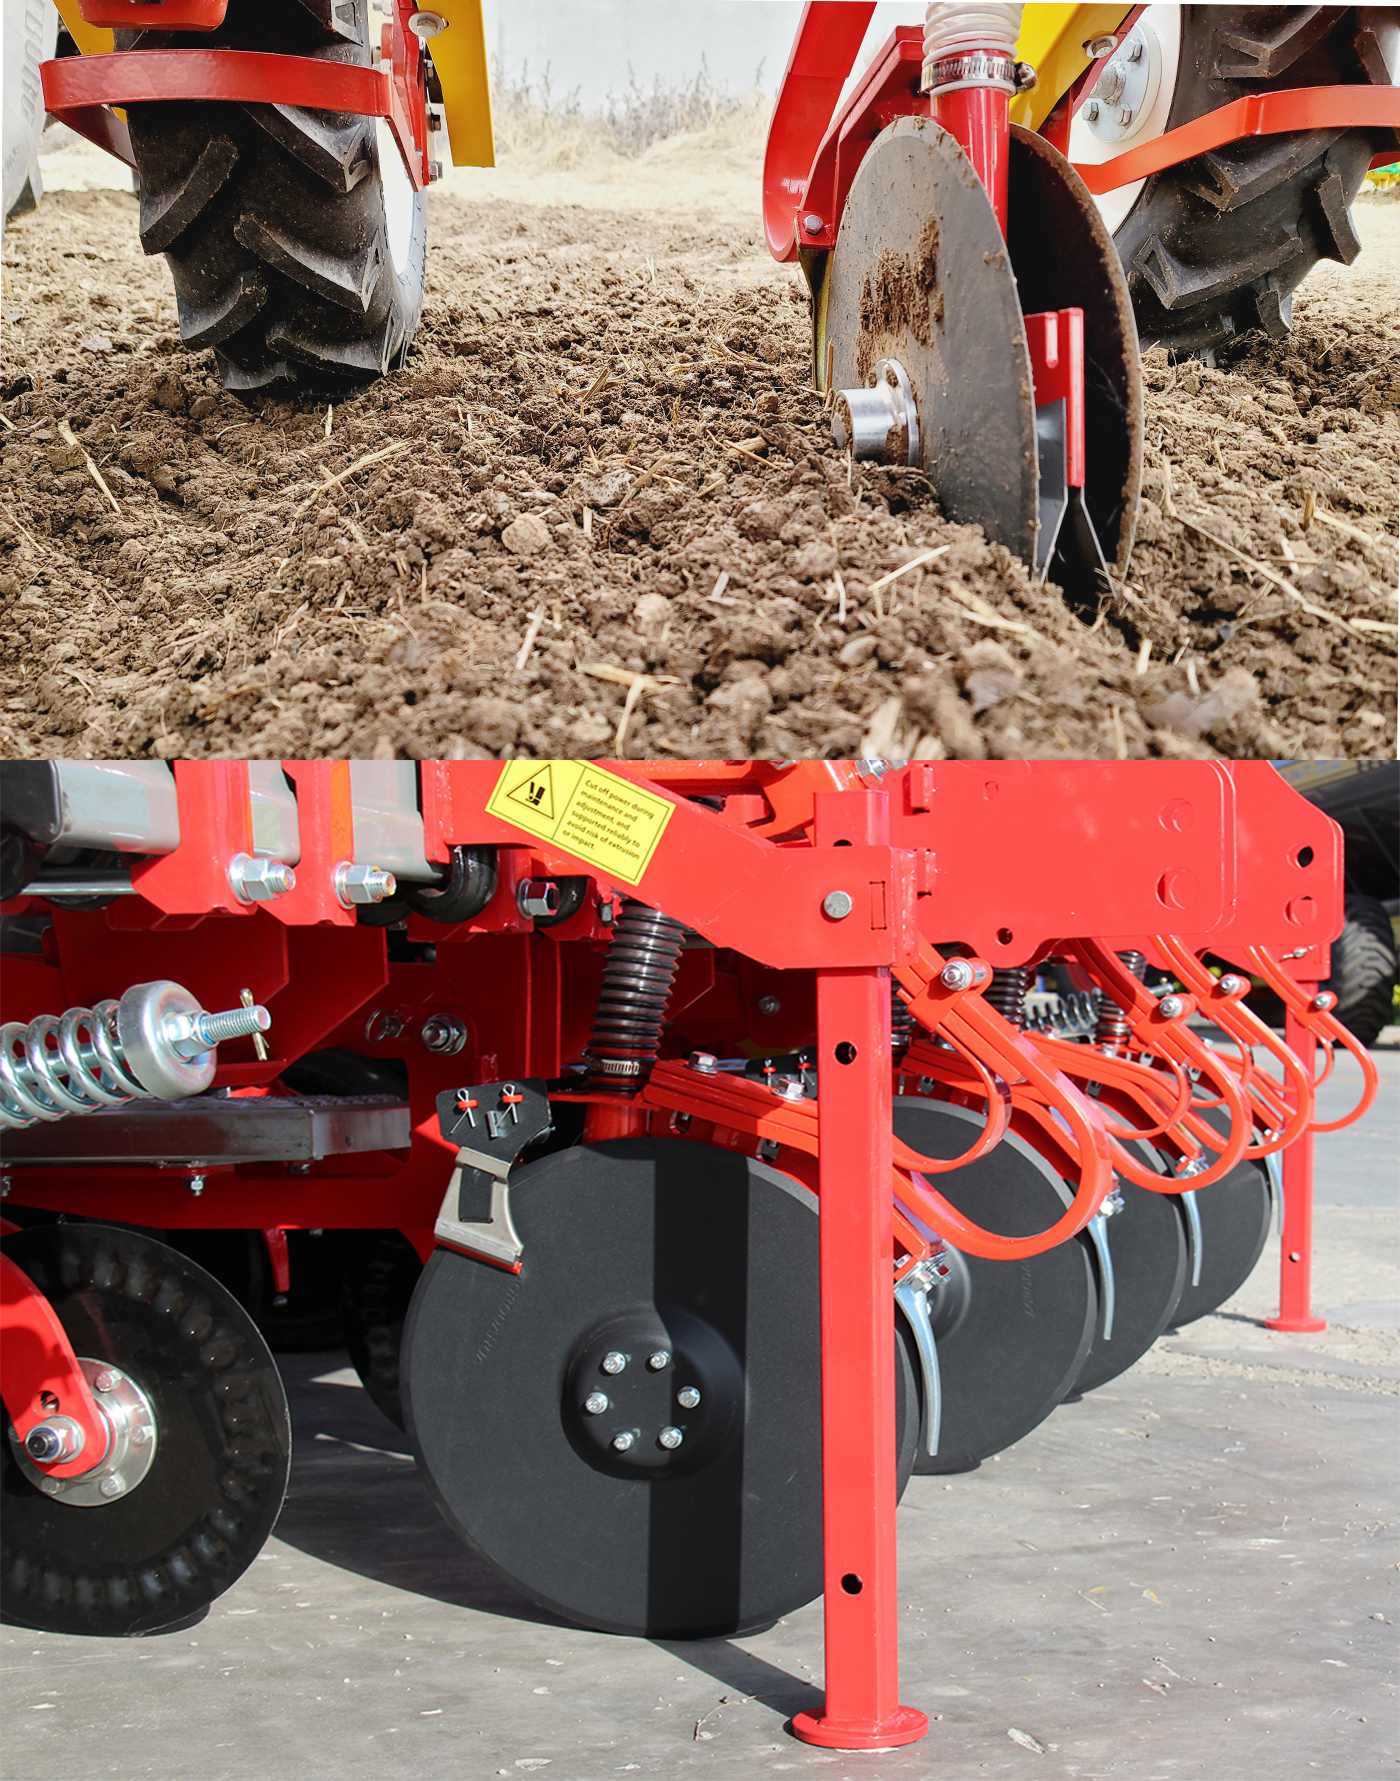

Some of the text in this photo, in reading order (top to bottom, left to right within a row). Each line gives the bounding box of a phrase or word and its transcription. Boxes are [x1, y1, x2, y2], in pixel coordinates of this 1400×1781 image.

[576, 801, 630, 830] adjustment, and
[580, 791, 638, 822] maintenance and
[585, 780, 654, 820] Cut off power during
[567, 821, 587, 833] avoid
[586, 830, 599, 839] risk
[608, 841, 640, 859] extrusion
[571, 834, 595, 849] impact.
[572, 810, 640, 848] supported reliably to
